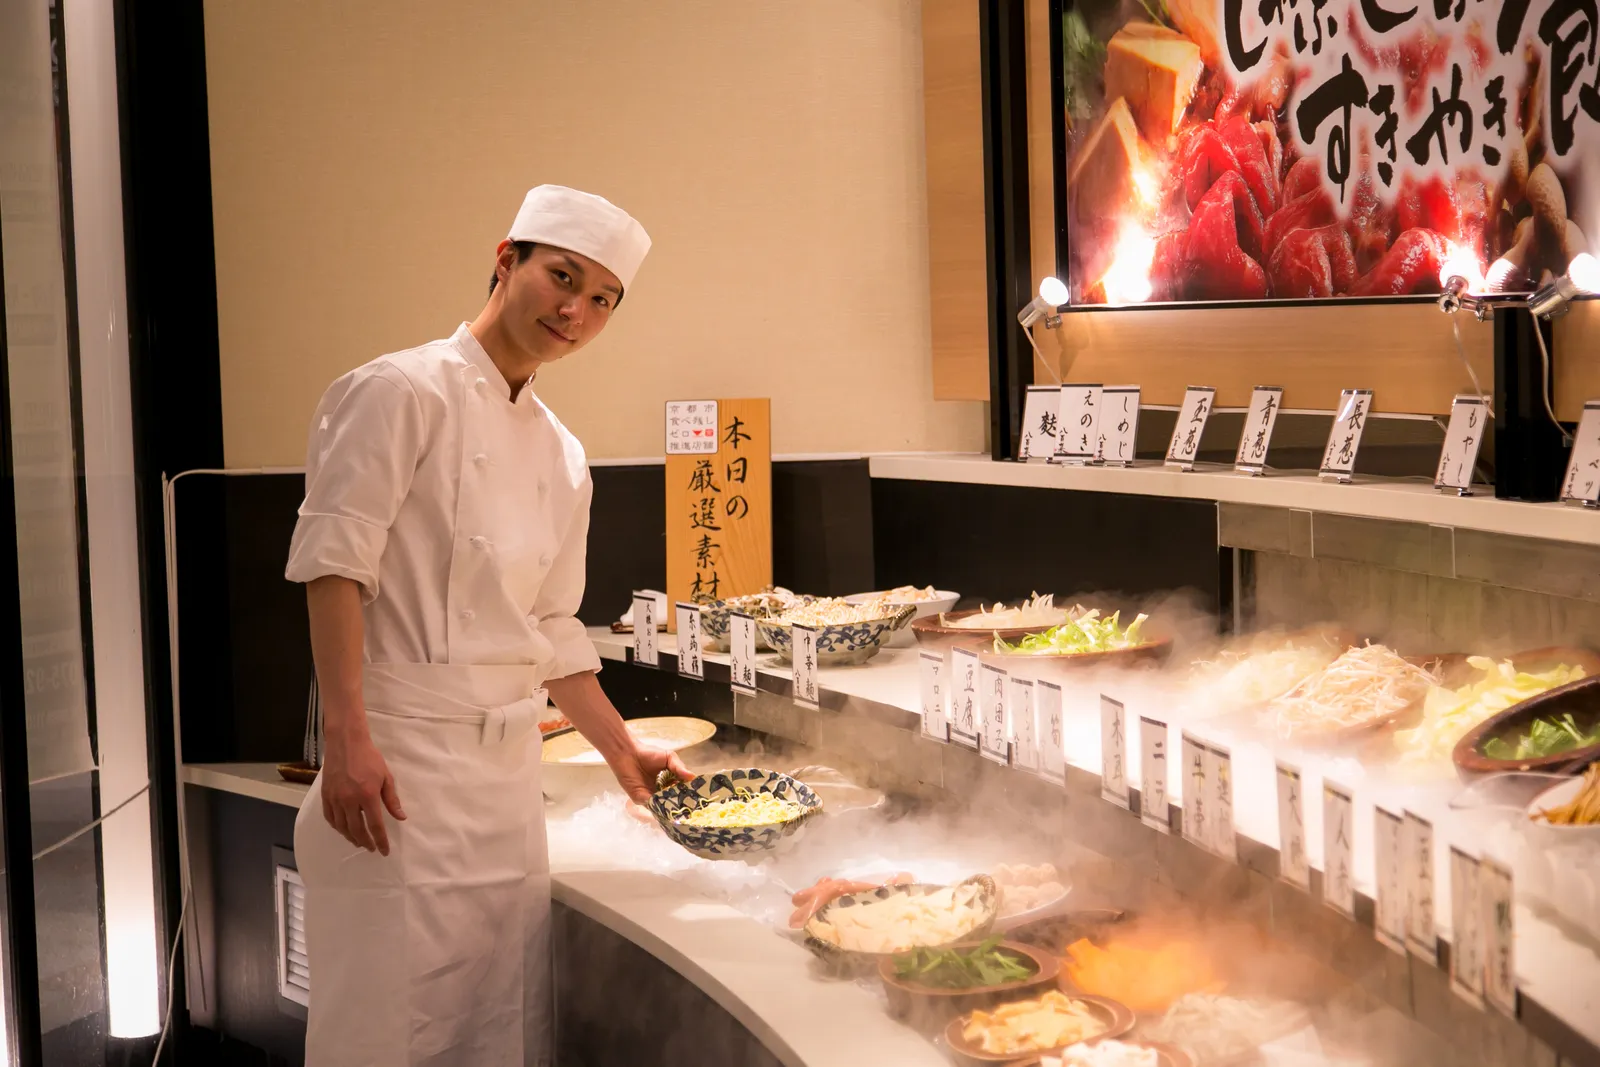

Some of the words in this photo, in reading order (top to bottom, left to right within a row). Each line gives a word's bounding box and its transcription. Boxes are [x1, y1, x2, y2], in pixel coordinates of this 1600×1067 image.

[1296, 54, 1508, 204] すきやき
[669, 404, 714, 414] 京都市
[669, 416, 714, 426] 食べ残し
[1080, 389, 1094, 451] えのき
[1118, 396, 1130, 458] しめじ
[1181, 397, 1207, 456] 玉葱
[1251, 395, 1276, 459] 青葱
[1337, 400, 1364, 464] 長葱
[723, 416, 751, 520] 本日の
[1457, 408, 1477, 483] もやし
[687, 459, 722, 600] 厳選素材
[932, 665, 941, 731] マロニー
[962, 663, 975, 731] 豆腐
[994, 675, 1004, 750] 肉団子
[1153, 741, 1165, 807] ニラ
